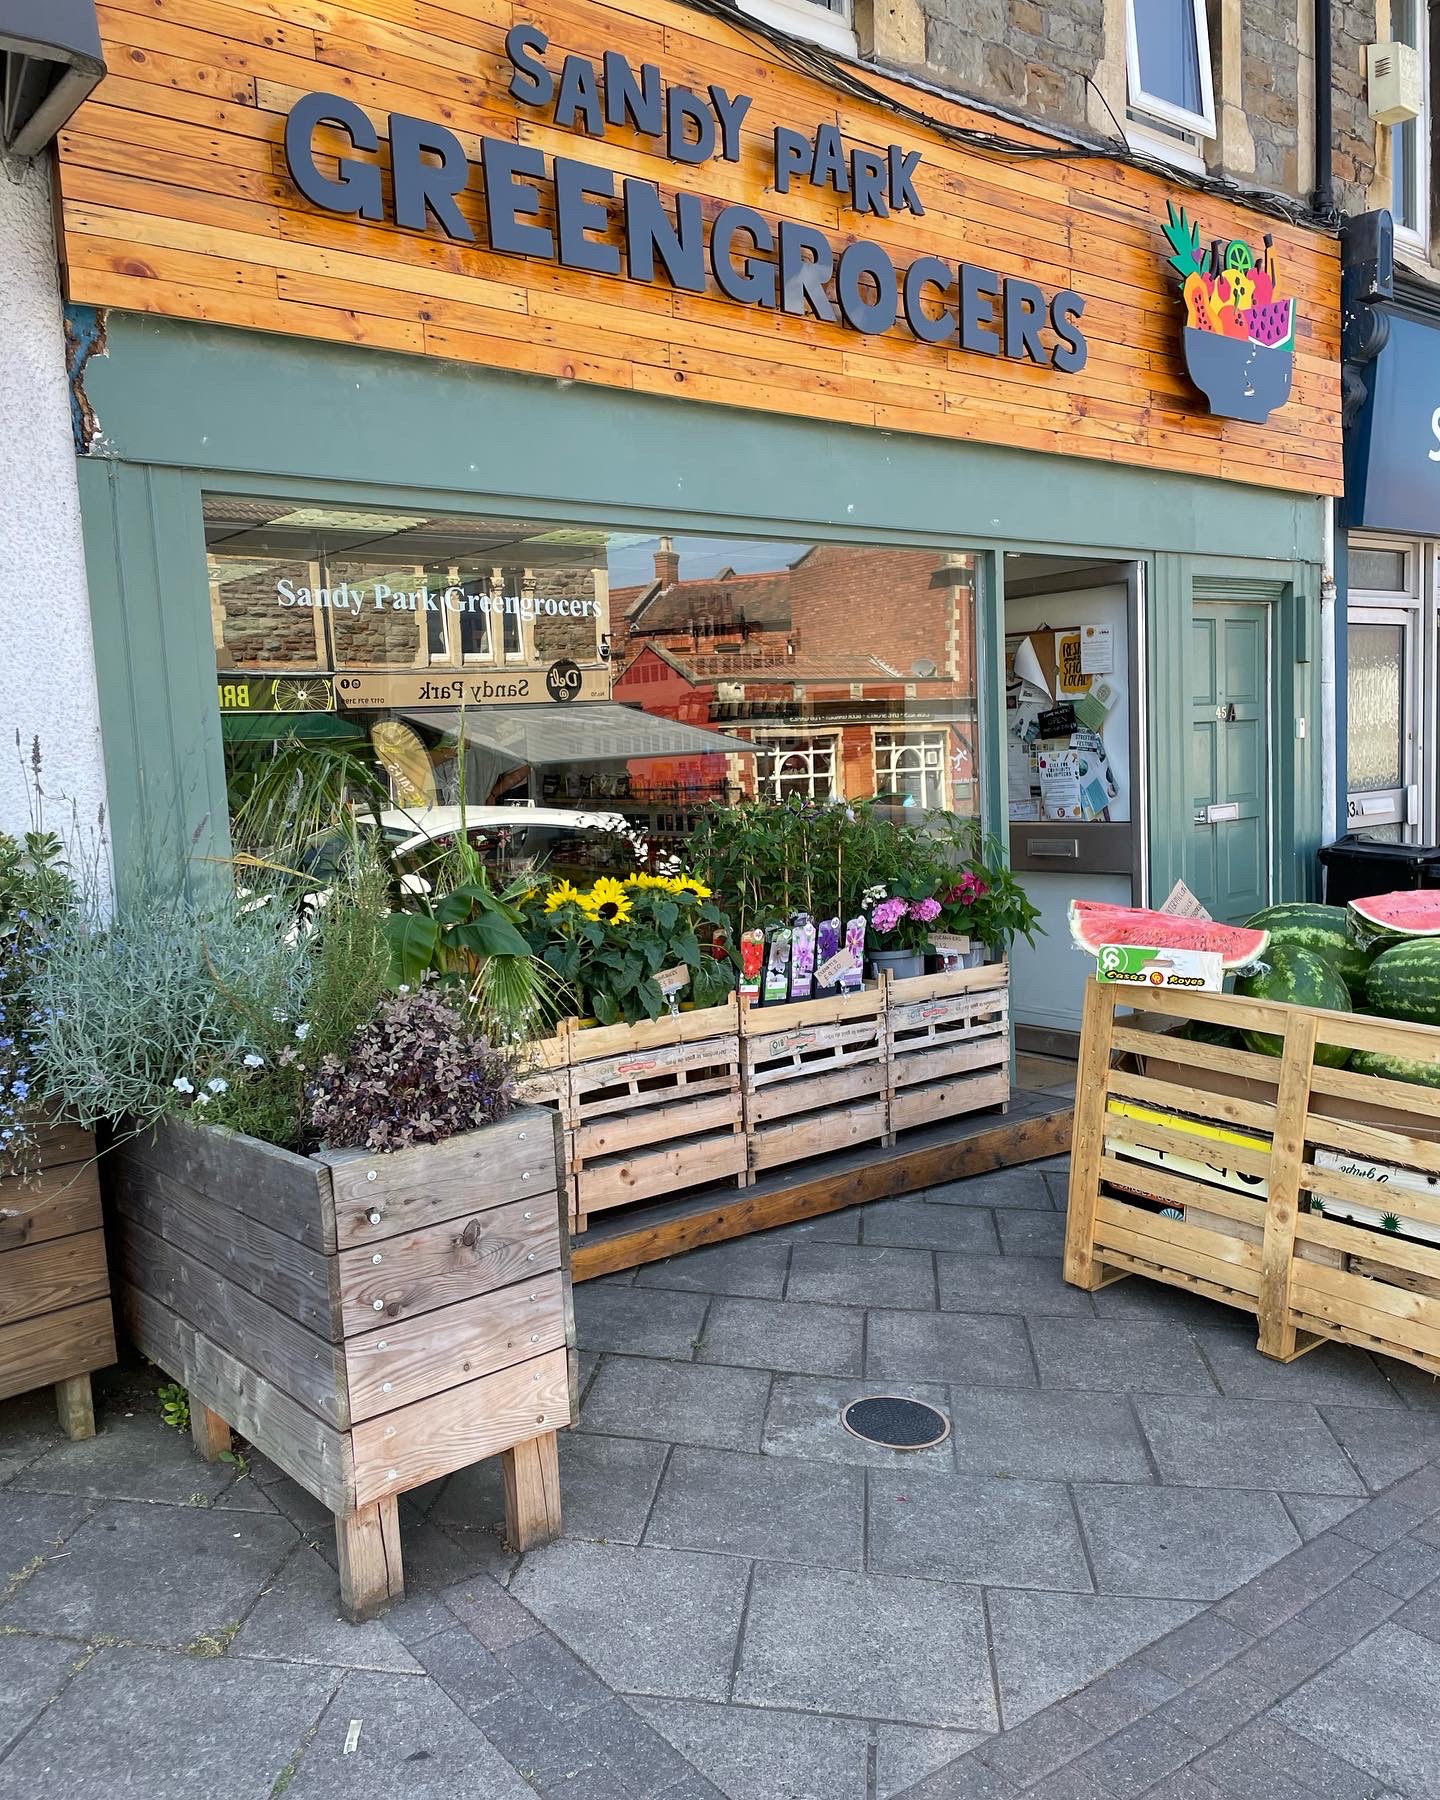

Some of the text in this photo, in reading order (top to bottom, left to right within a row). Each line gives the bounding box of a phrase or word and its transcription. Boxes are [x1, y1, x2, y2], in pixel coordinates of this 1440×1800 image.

[505, 24, 925, 218] SANDY PARK
[285, 92, 1088, 374] GREENGROCERS
[277, 579, 602, 622] Sandy Park Greengrocers
[1063, 661, 1081, 675] SHO
[1063, 674, 1089, 687] LOCAL
[1105, 970, 1146, 981] Casas
[1168, 975, 1205, 986] Royes
